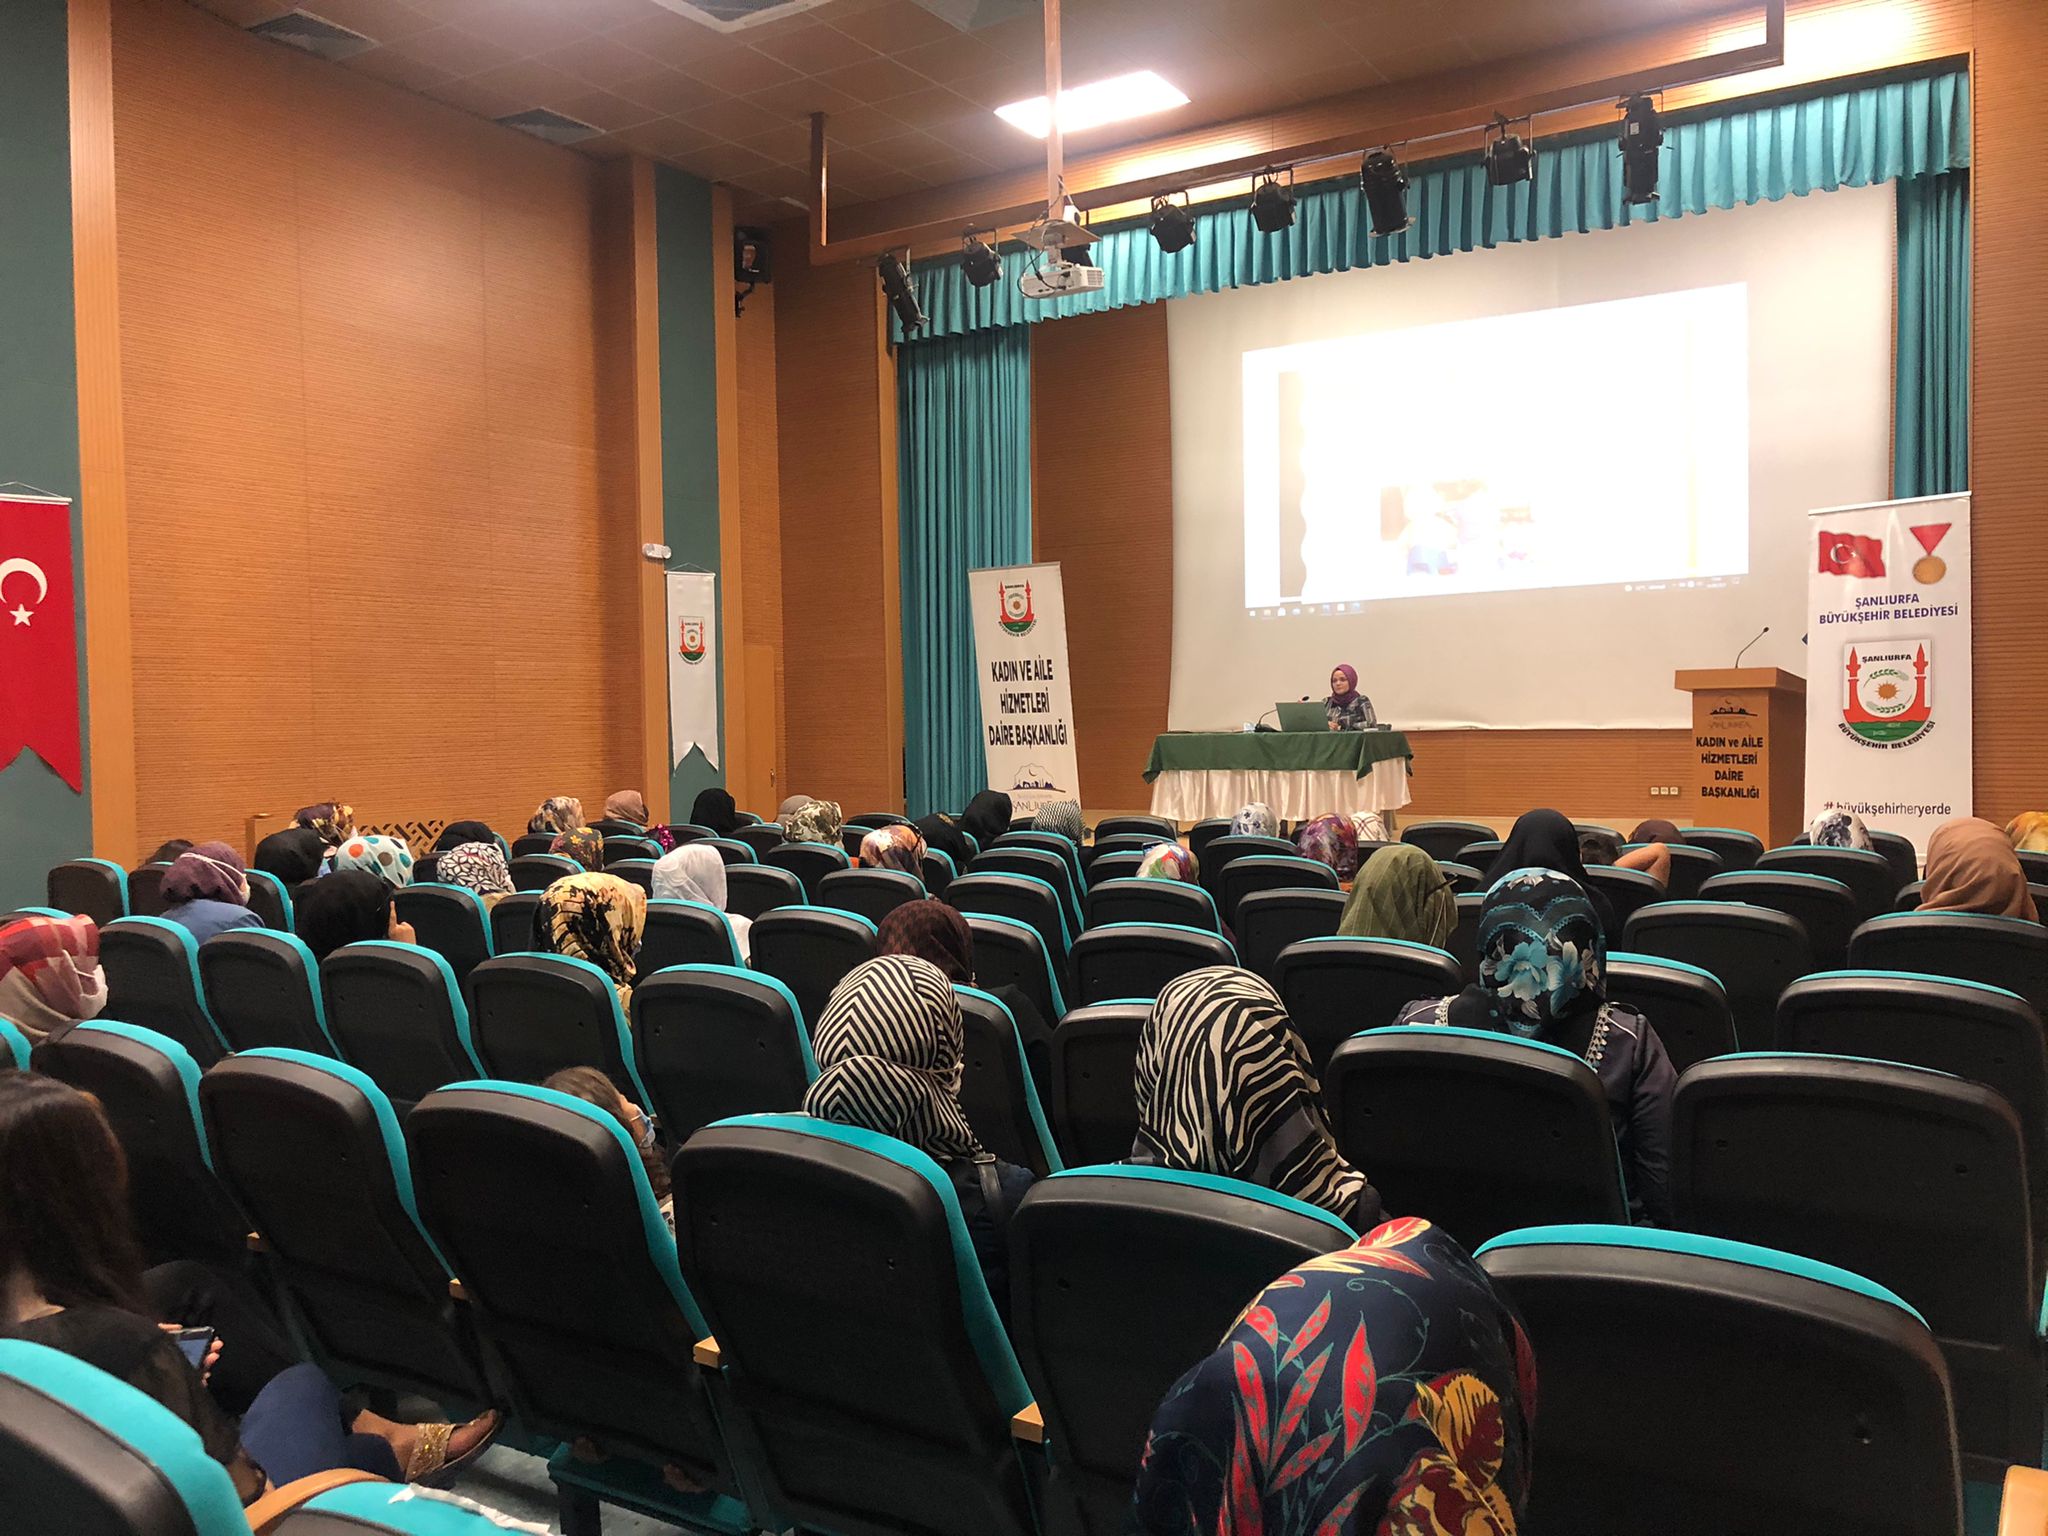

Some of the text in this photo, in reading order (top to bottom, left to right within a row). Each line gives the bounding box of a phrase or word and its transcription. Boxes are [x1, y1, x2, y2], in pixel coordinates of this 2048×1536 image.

[1855, 593, 1919, 609] ŞANLIURFA
[1819, 602, 1958, 624] BÜYÜKŞEHİR BELEDİYESİ
[1861, 654, 1912, 664] ŞANLIURFA
[991, 654, 1053, 682] KADIN VE AİLE
[999, 686, 1050, 714] HİZMETLERİ
[988, 718, 1068, 749] DAİRE BAŞKANLIĞI
[1696, 734, 1764, 748] KADIN ve AİLE
[1701, 751, 1758, 765] HİZMETLERİ
[1714, 768, 1744, 782] DAİRE
[1701, 785, 1760, 799] BAŞKANLIĞI
